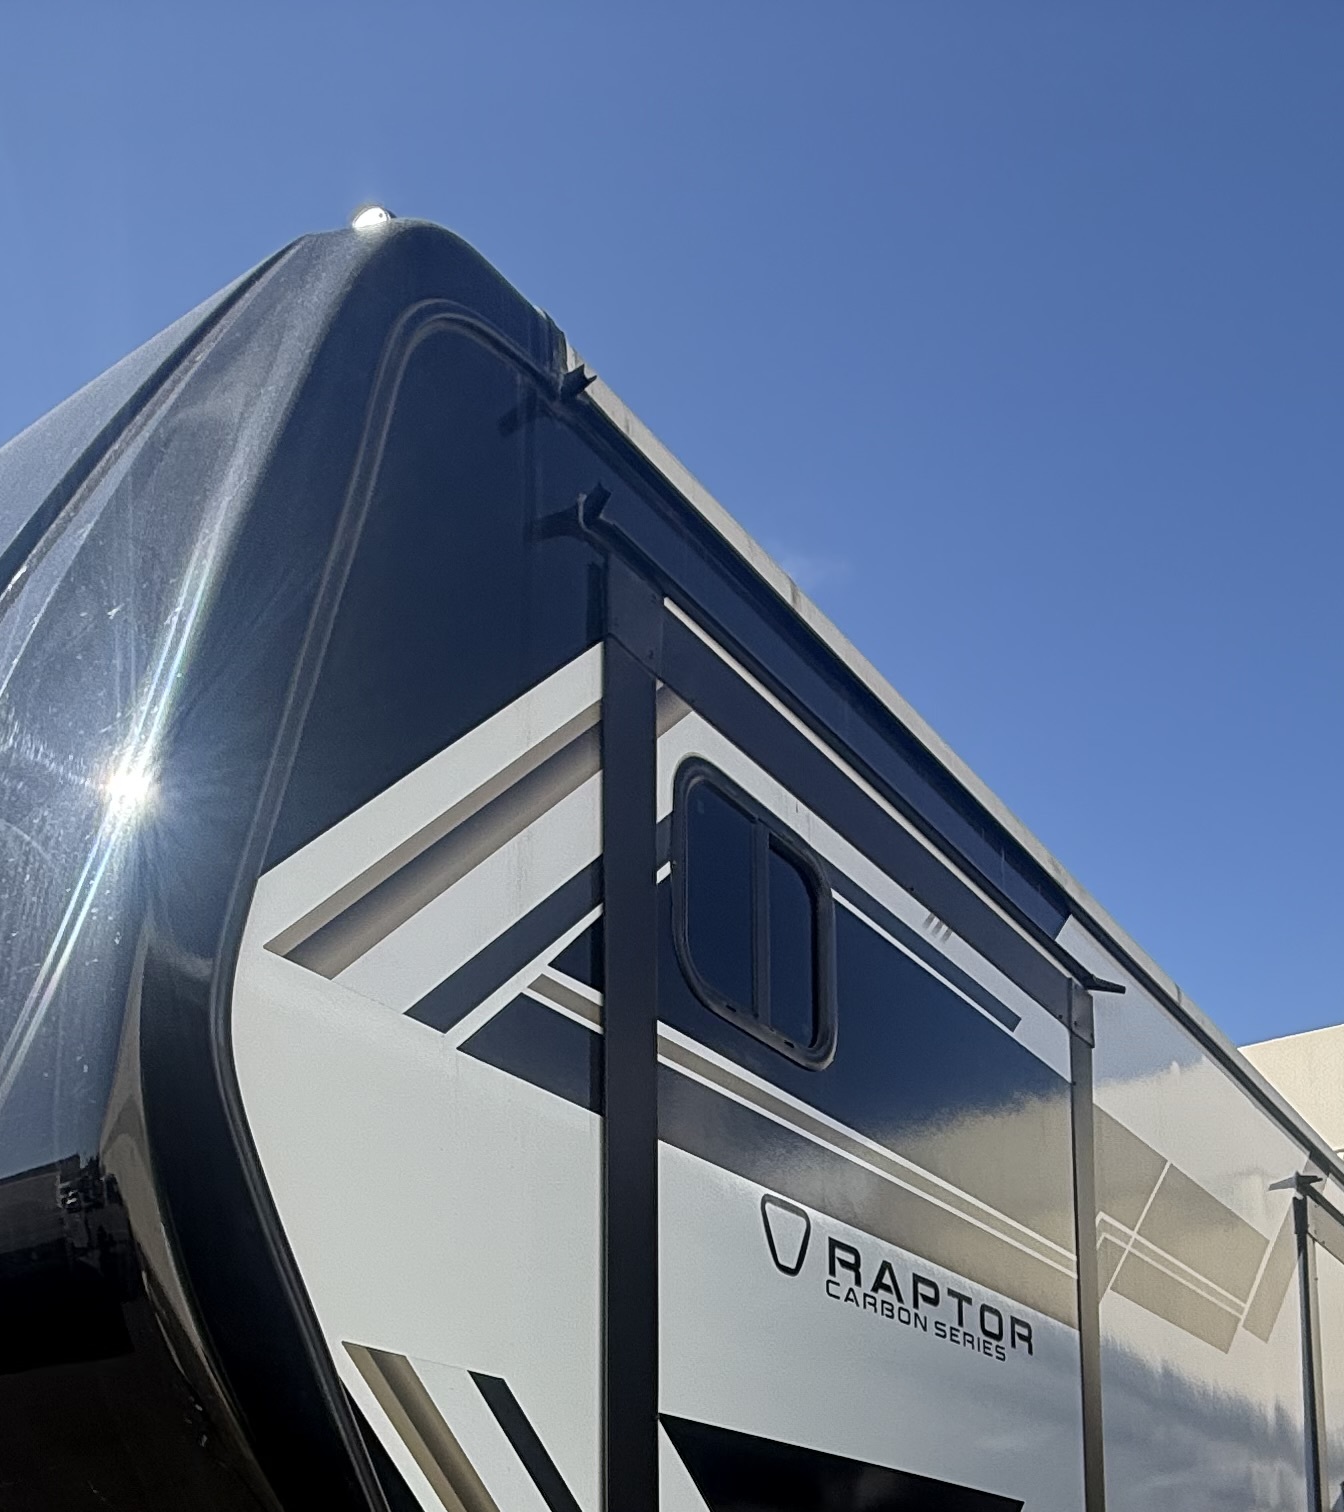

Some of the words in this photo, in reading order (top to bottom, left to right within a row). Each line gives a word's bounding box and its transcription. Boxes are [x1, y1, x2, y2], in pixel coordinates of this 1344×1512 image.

[824, 1278, 928, 1333] CARBON
[933, 1320, 1007, 1363] SERIES
[827, 1235, 1035, 1357] RAPTOR
